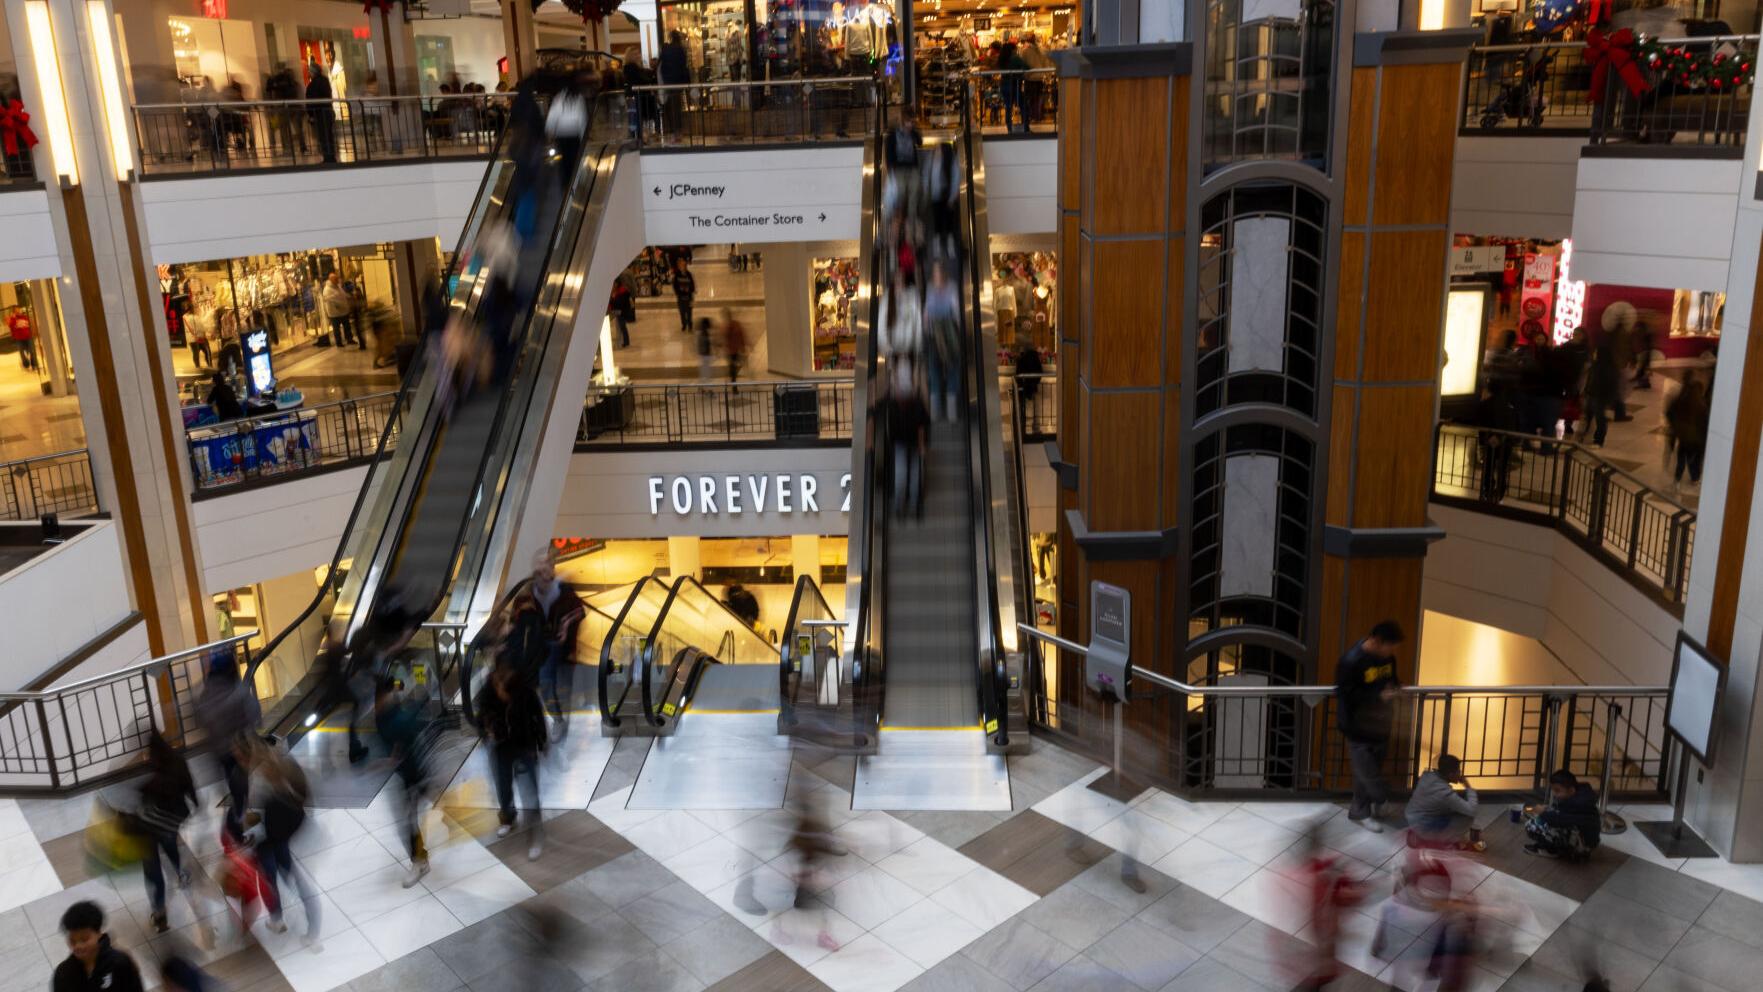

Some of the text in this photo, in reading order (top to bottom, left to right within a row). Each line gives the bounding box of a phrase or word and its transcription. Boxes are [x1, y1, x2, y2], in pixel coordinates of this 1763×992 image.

[669, 184, 725, 200] JCPenney
[689, 213, 804, 228] The Container Store
[649, 475, 819, 515] FOREVER
